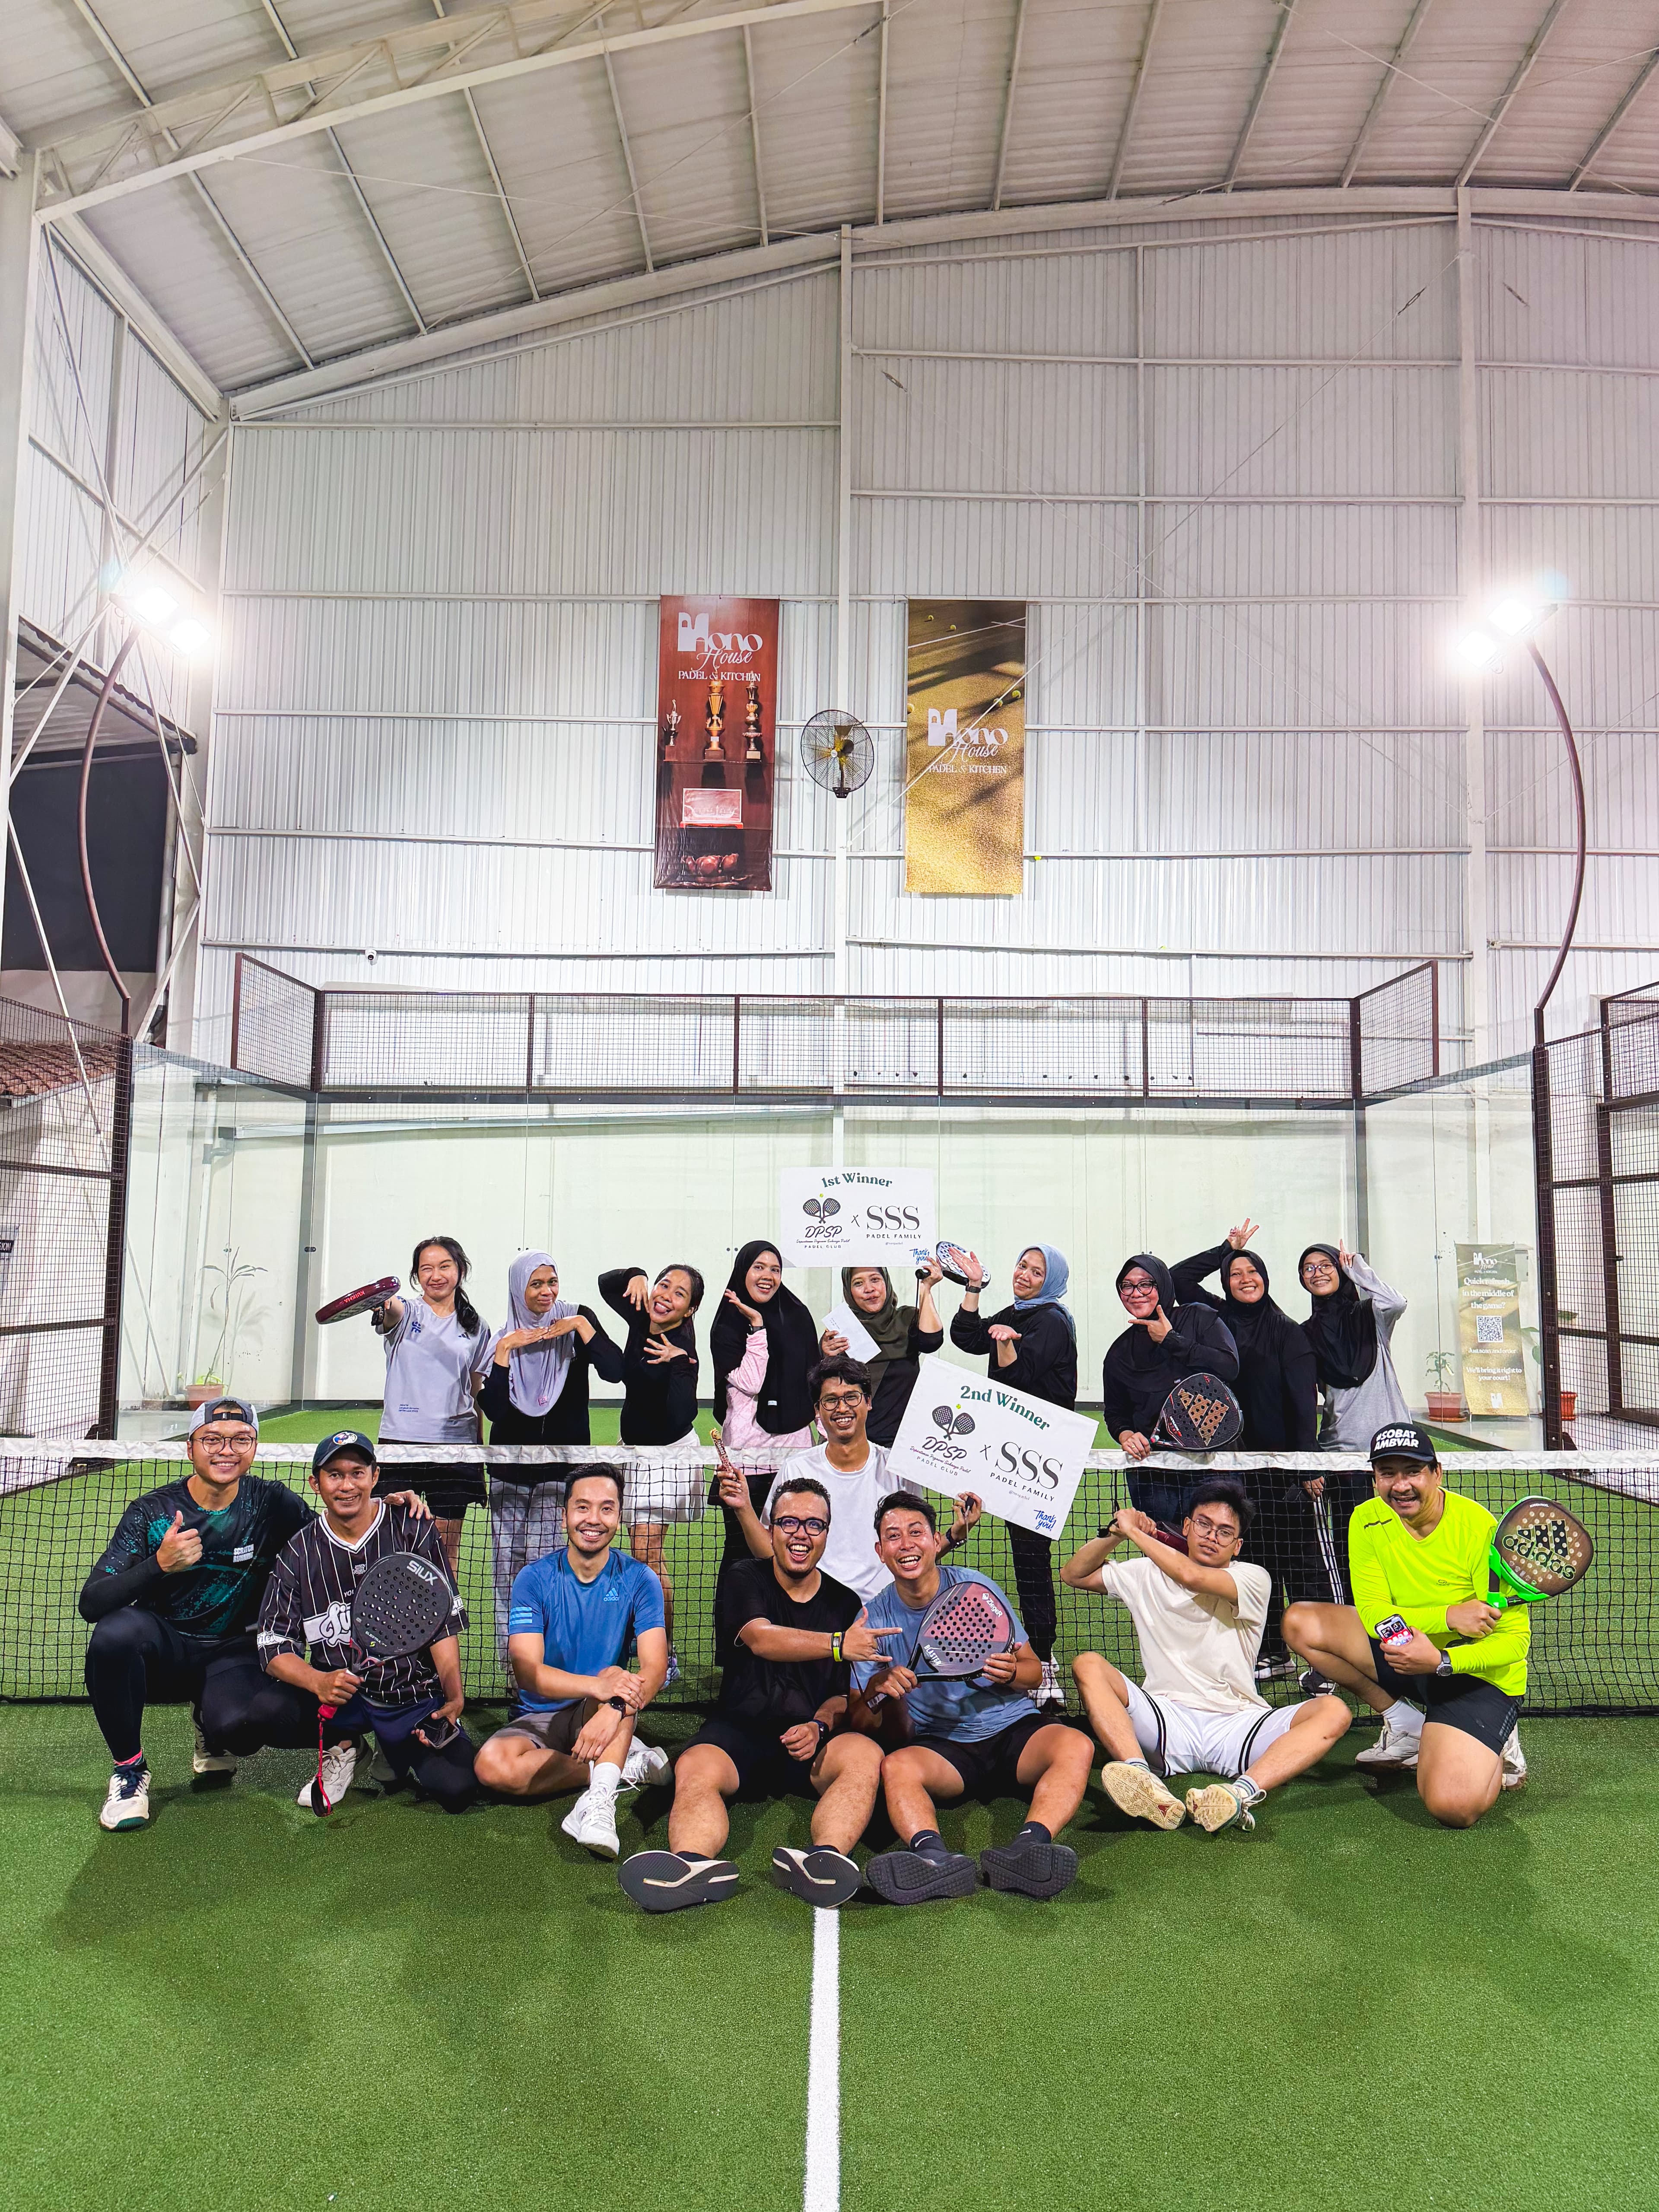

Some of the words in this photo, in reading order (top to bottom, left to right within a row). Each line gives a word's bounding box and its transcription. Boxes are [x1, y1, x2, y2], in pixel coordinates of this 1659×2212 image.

[691, 648, 753, 672] House
[678, 671, 707, 680] PADEL
[721, 672, 761, 682] KITCHEN
[941, 743, 999, 766] House
[969, 765, 1007, 773] KITCHEN
[822, 1176, 841, 1188] 1st
[842, 1173, 892, 1187] Winner
[867, 1205, 919, 1230] SSS
[805, 1226, 842, 1238] DPSP
[344, 1290, 365, 1303] KUIKMA
[960, 1386, 992, 1403] 2nd
[996, 1391, 1050, 1430] Winner
[1376, 1429, 1417, 1442] #SOBAT
[922, 1437, 967, 1461] DPSP
[917, 1456, 937, 1468] PADEL
[941, 1466, 958, 1476] CLUB
[995, 1441, 1063, 1489] SSS
[990, 1472, 1017, 1487] PADEL
[1022, 1485, 1055, 1502] FAMILY
[1033, 1510, 1056, 1523] Thank
[234, 1544, 254, 1555] SCRATCH
[1502, 1535, 1576, 1580] adidas
[407, 1560, 438, 1586] SIUX
